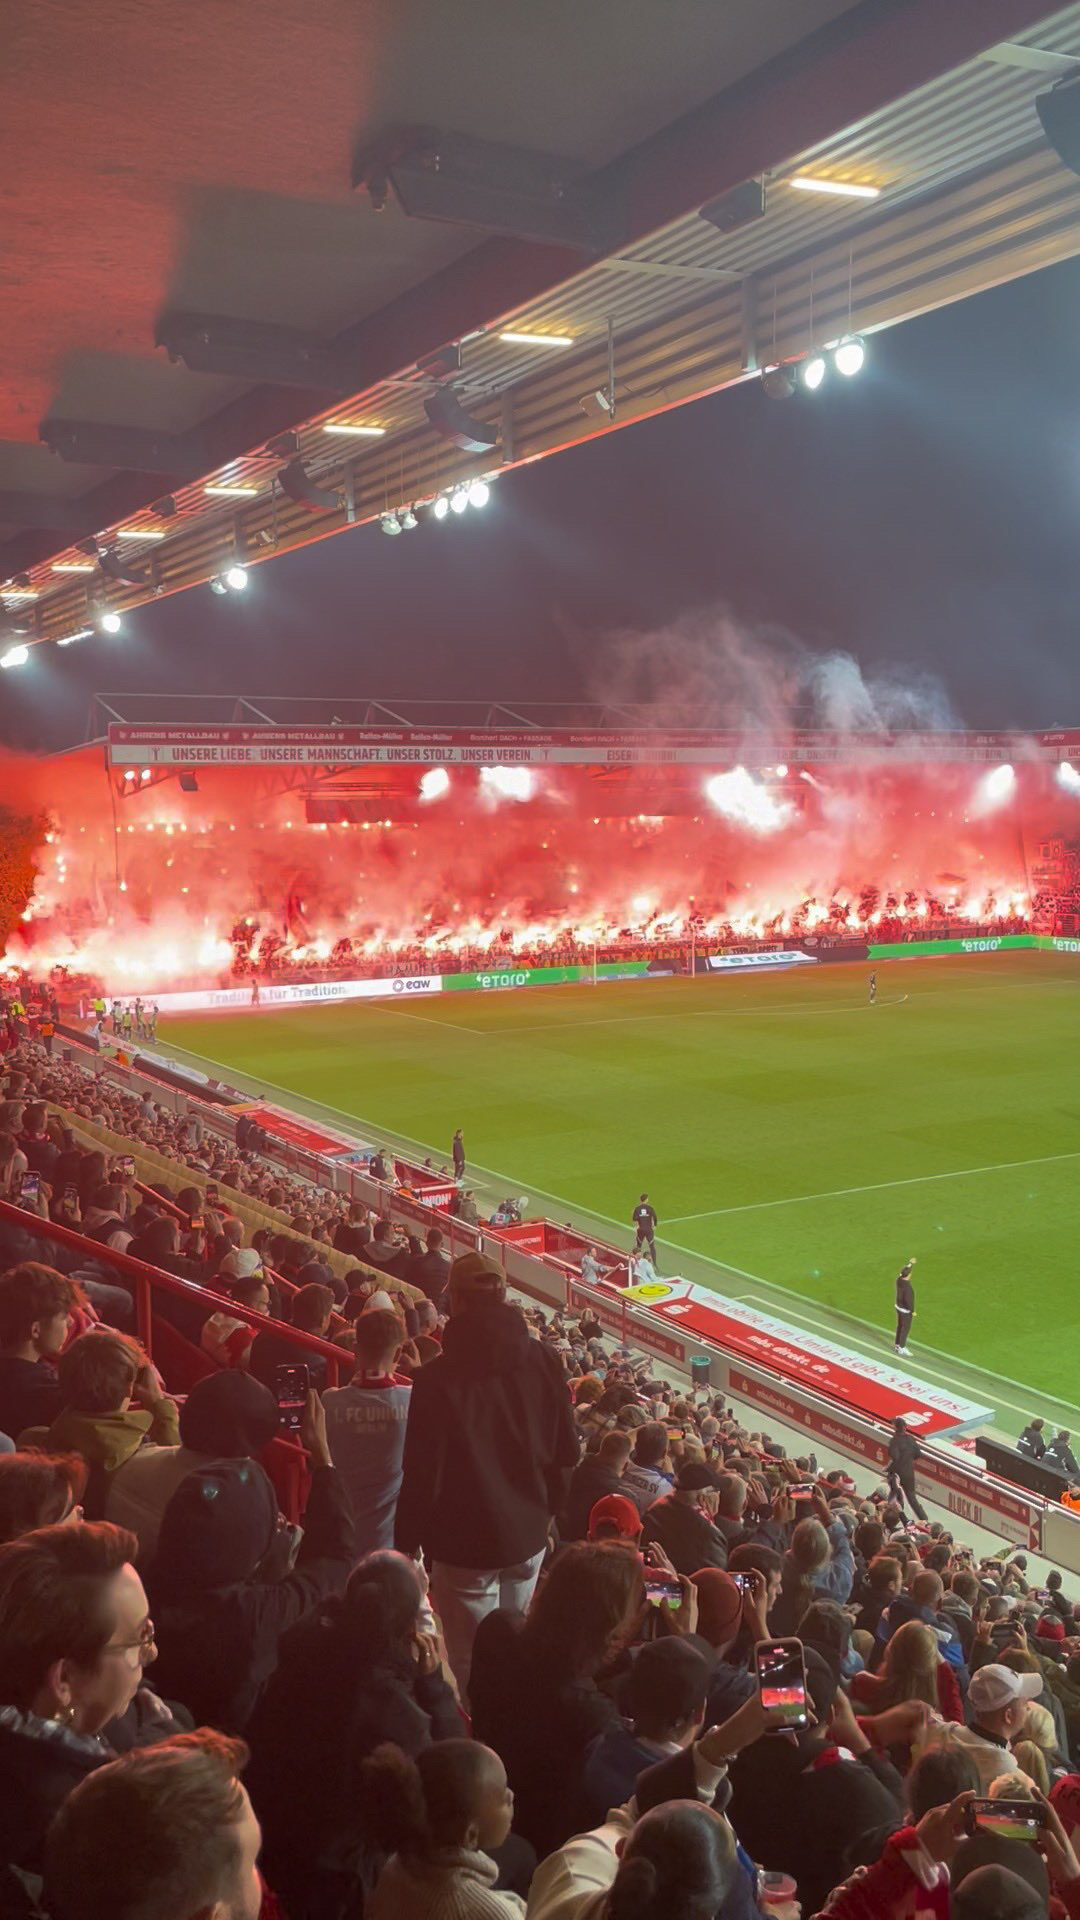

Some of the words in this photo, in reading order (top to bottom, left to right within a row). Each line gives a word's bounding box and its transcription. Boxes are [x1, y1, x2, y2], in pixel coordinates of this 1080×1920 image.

[172, 748, 217, 760] UNSERE
[261, 749, 302, 760] UNSERE
[307, 749, 382, 760] MANNSCHAFT.
[387, 749, 420, 760] UNSER
[423, 749, 457, 760] STOLZ.
[461, 749, 494, 760] UNSER
[290, 986, 346, 997] Tradition
